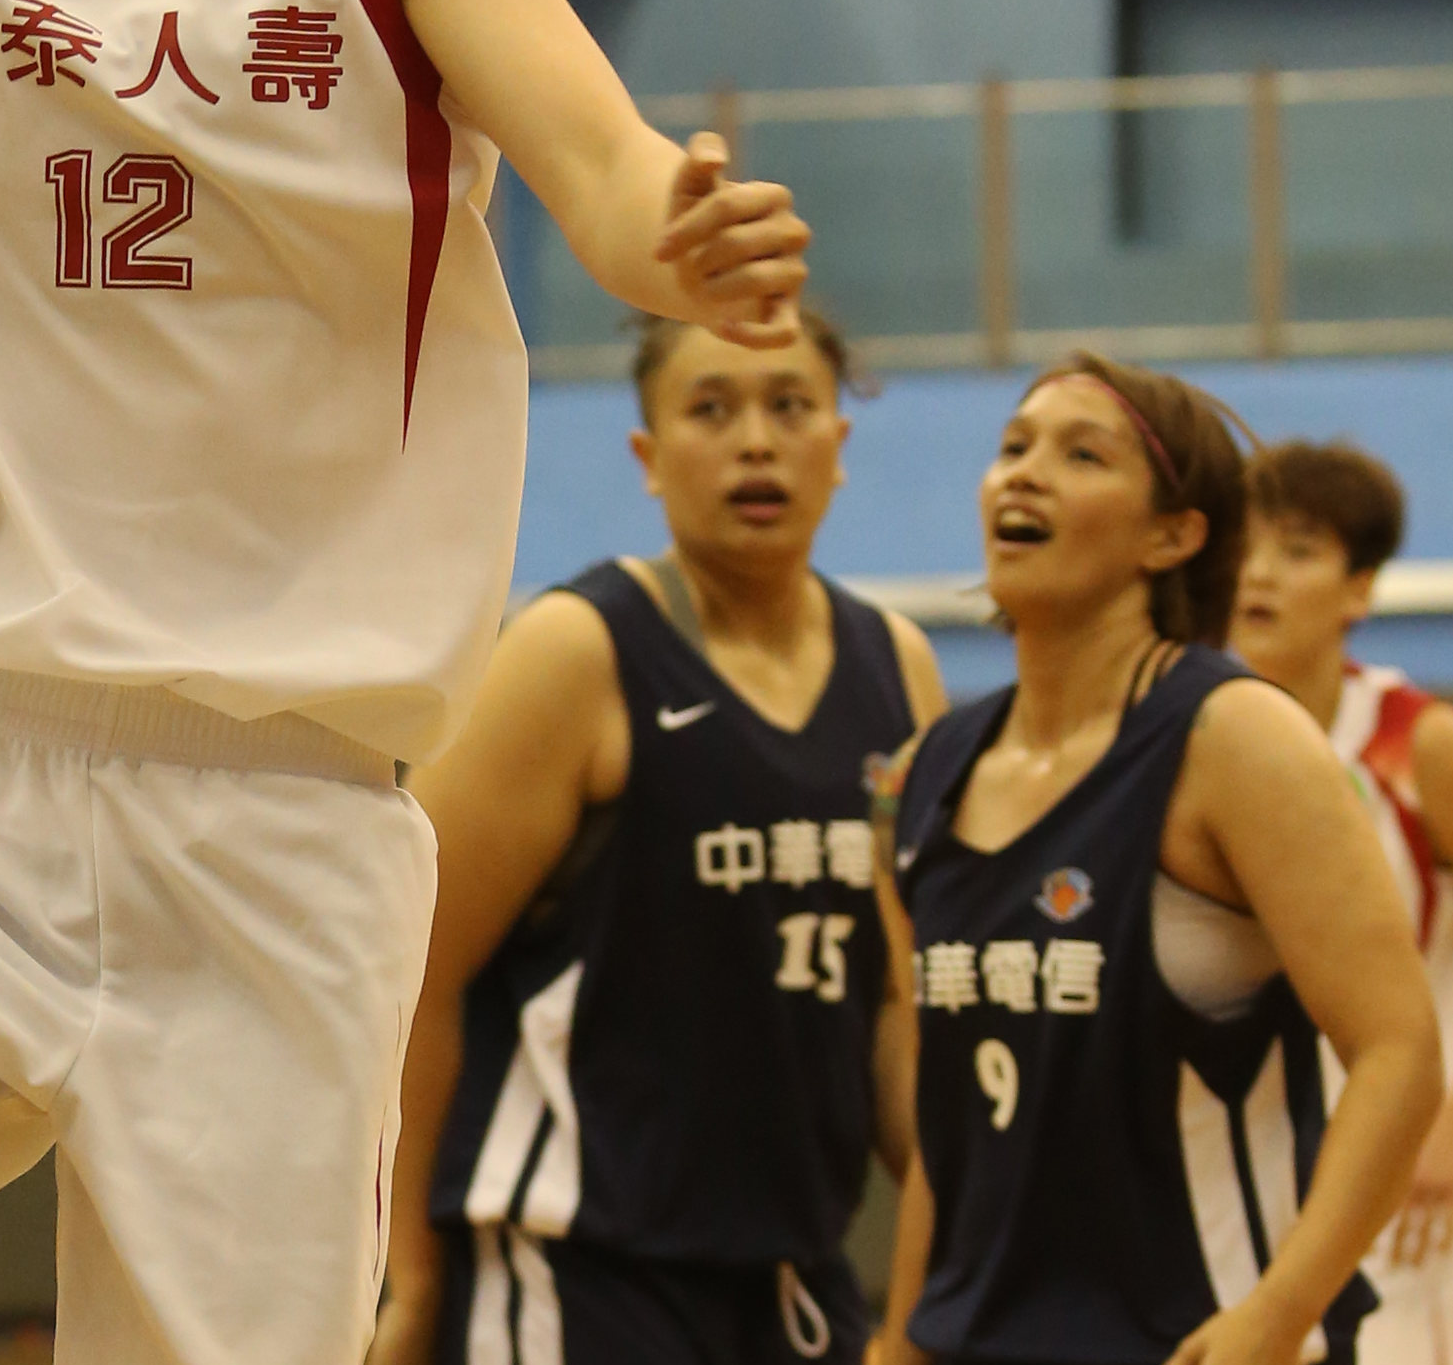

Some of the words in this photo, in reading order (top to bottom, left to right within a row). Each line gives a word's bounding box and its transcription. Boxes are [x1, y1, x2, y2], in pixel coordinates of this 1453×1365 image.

[45, 149, 194, 290] 12
[775, 912, 855, 1003] 15
[912, 938, 1105, 1014] 華電信
[975, 1037, 1019, 1131] 9
